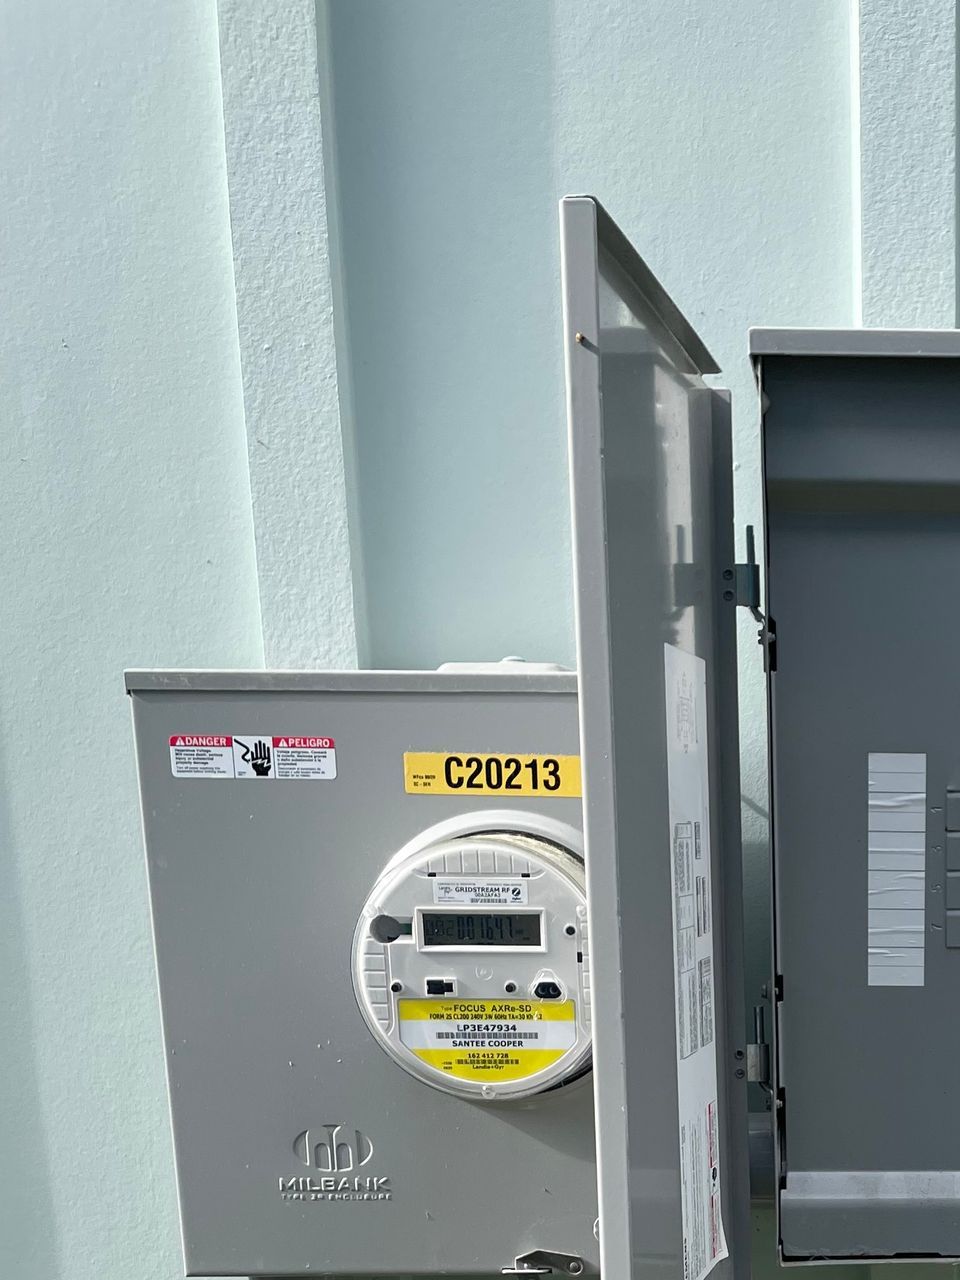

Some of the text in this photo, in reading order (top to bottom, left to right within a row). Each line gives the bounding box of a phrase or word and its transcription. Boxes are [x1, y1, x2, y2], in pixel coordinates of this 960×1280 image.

[185, 737, 226, 746] DANGER
[288, 738, 330, 747] PELIGRO
[444, 756, 561, 791] C20213
[454, 1004, 486, 1012] FOCUS
[491, 1004, 532, 1012] AXRe-SD
[456, 1024, 517, 1032] LP3E47934
[278, 1176, 392, 1192] MILBANK
